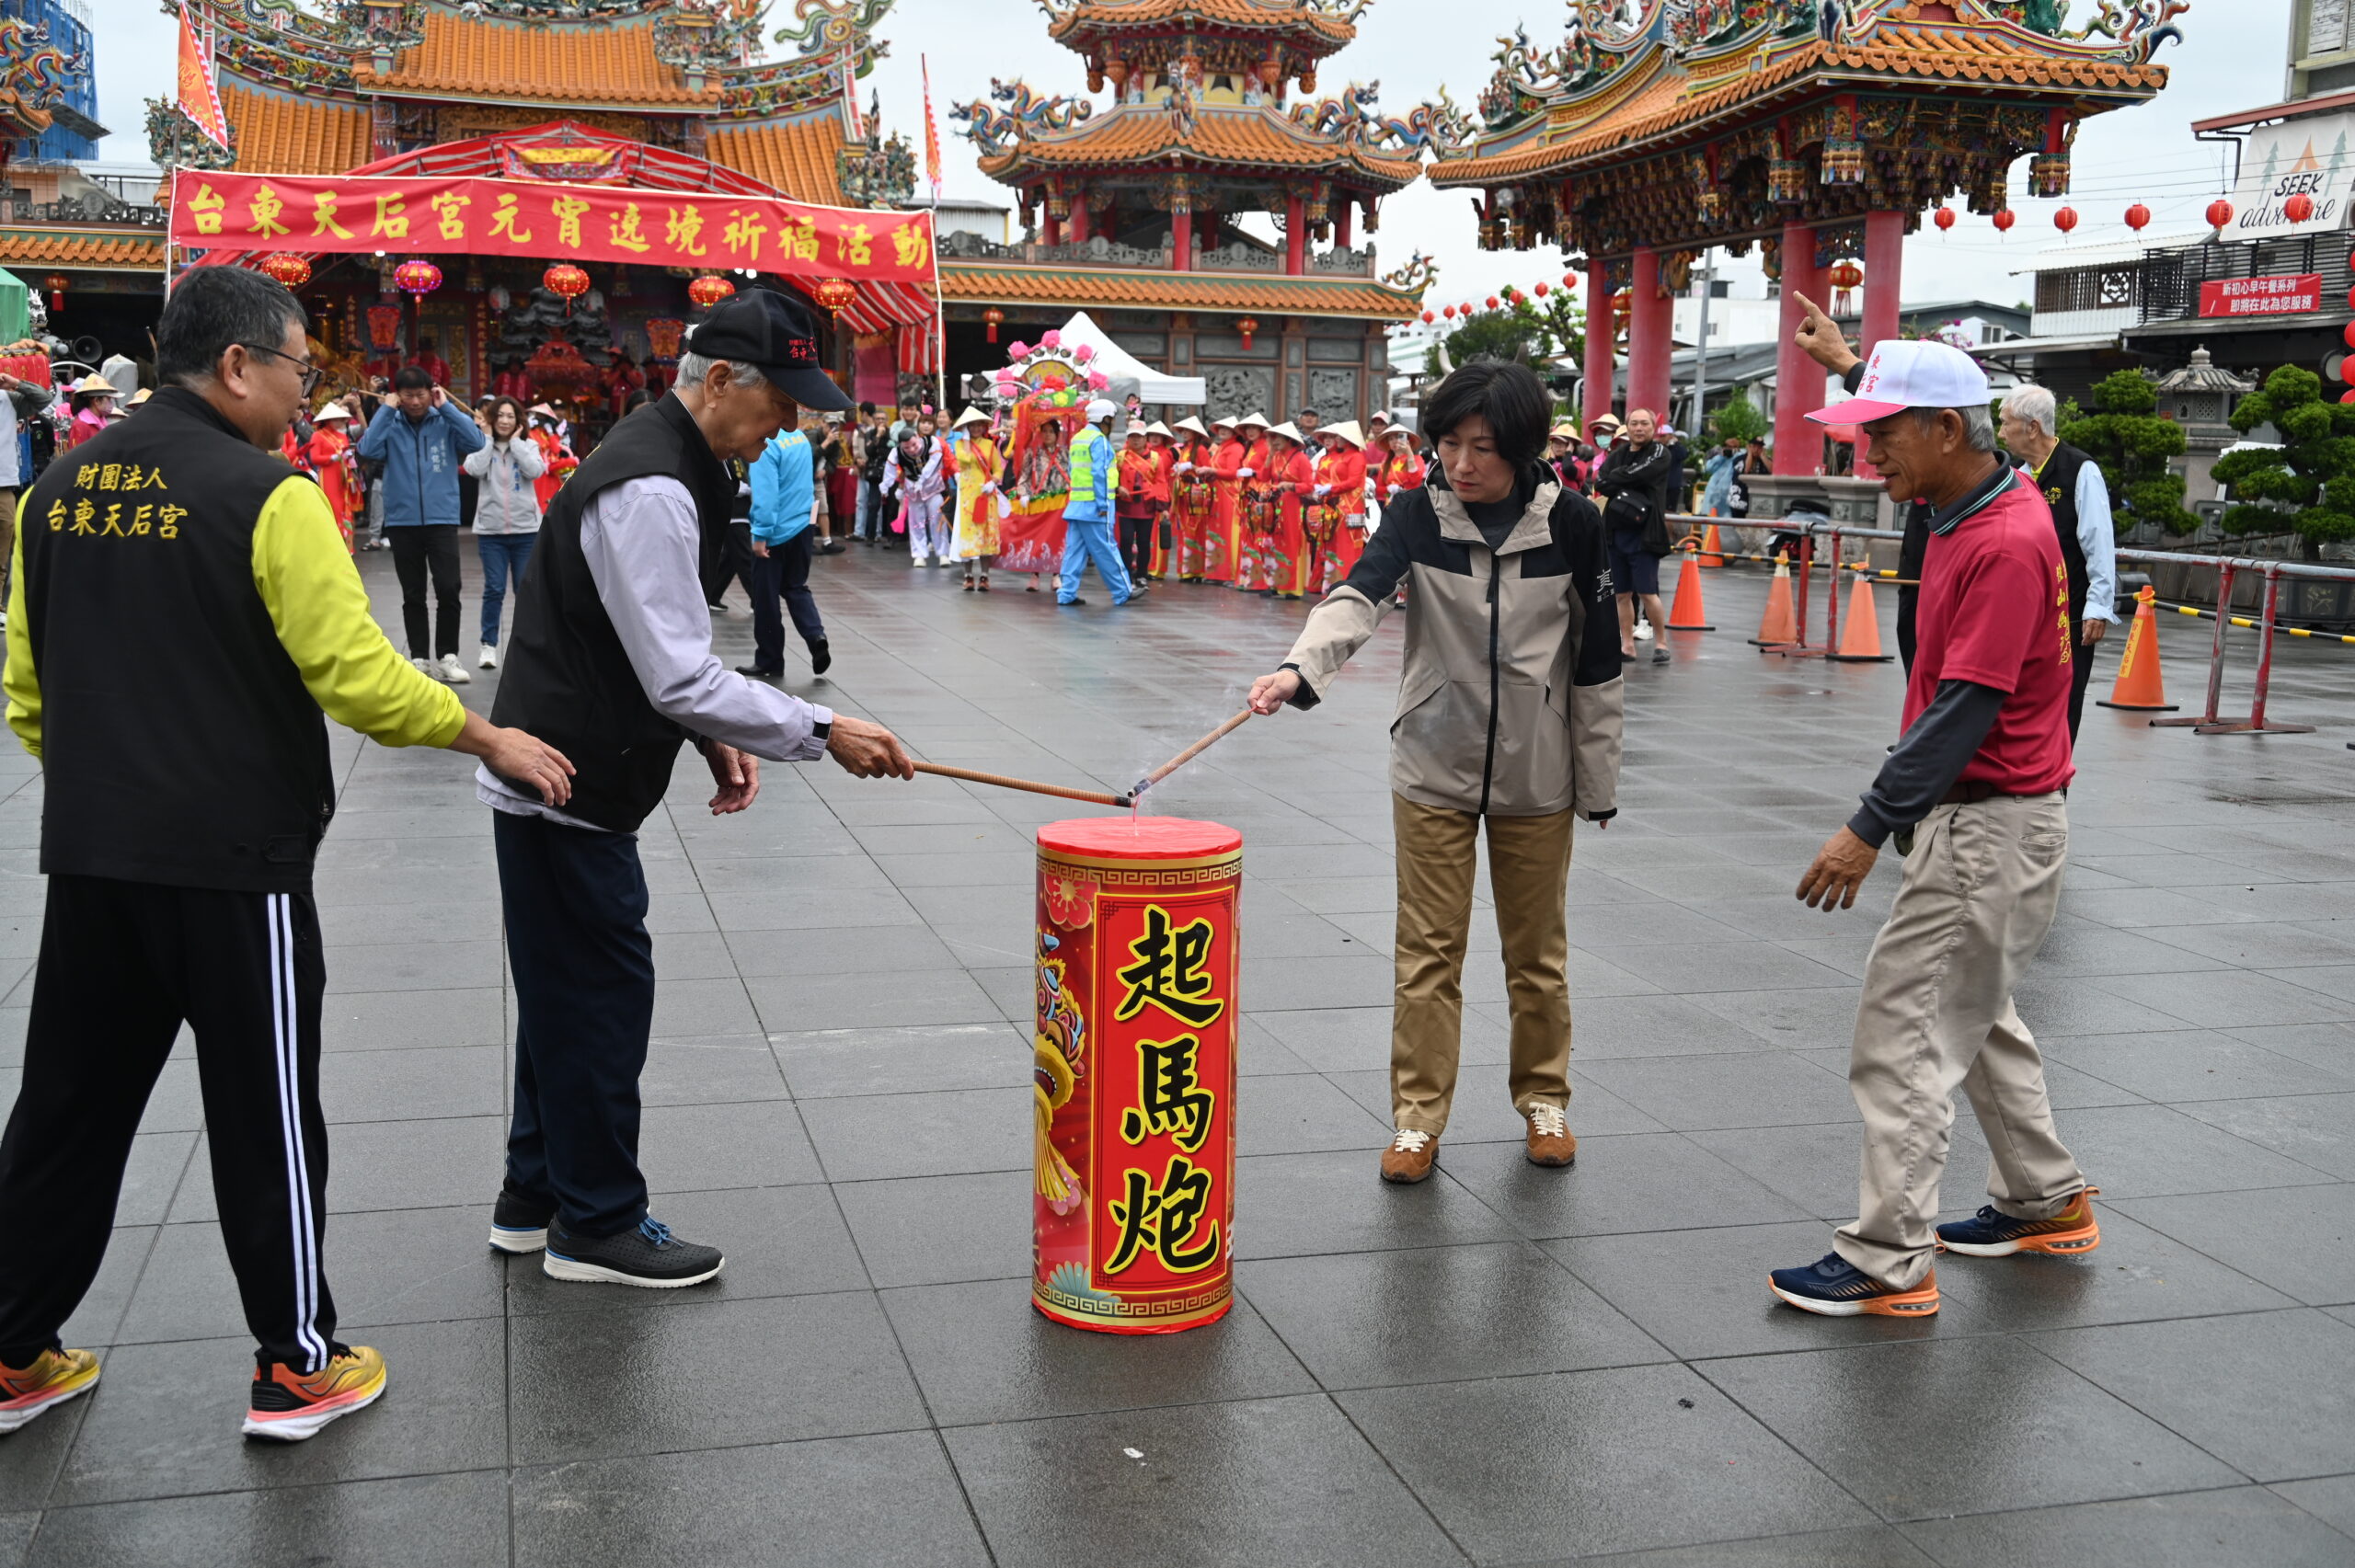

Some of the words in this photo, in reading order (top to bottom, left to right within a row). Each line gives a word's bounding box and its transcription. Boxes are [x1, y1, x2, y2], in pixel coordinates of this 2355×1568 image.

[2274, 173, 2324, 197] SEEK
[187, 182, 929, 270] 台東天后宮元宵遶境祈福活動
[2230, 295, 2313, 313] 即將在此為您服務
[74, 463, 168, 491] 財團法人
[47, 498, 189, 540] 台東天后宮
[1107, 907, 1223, 1272] 起馬炮
